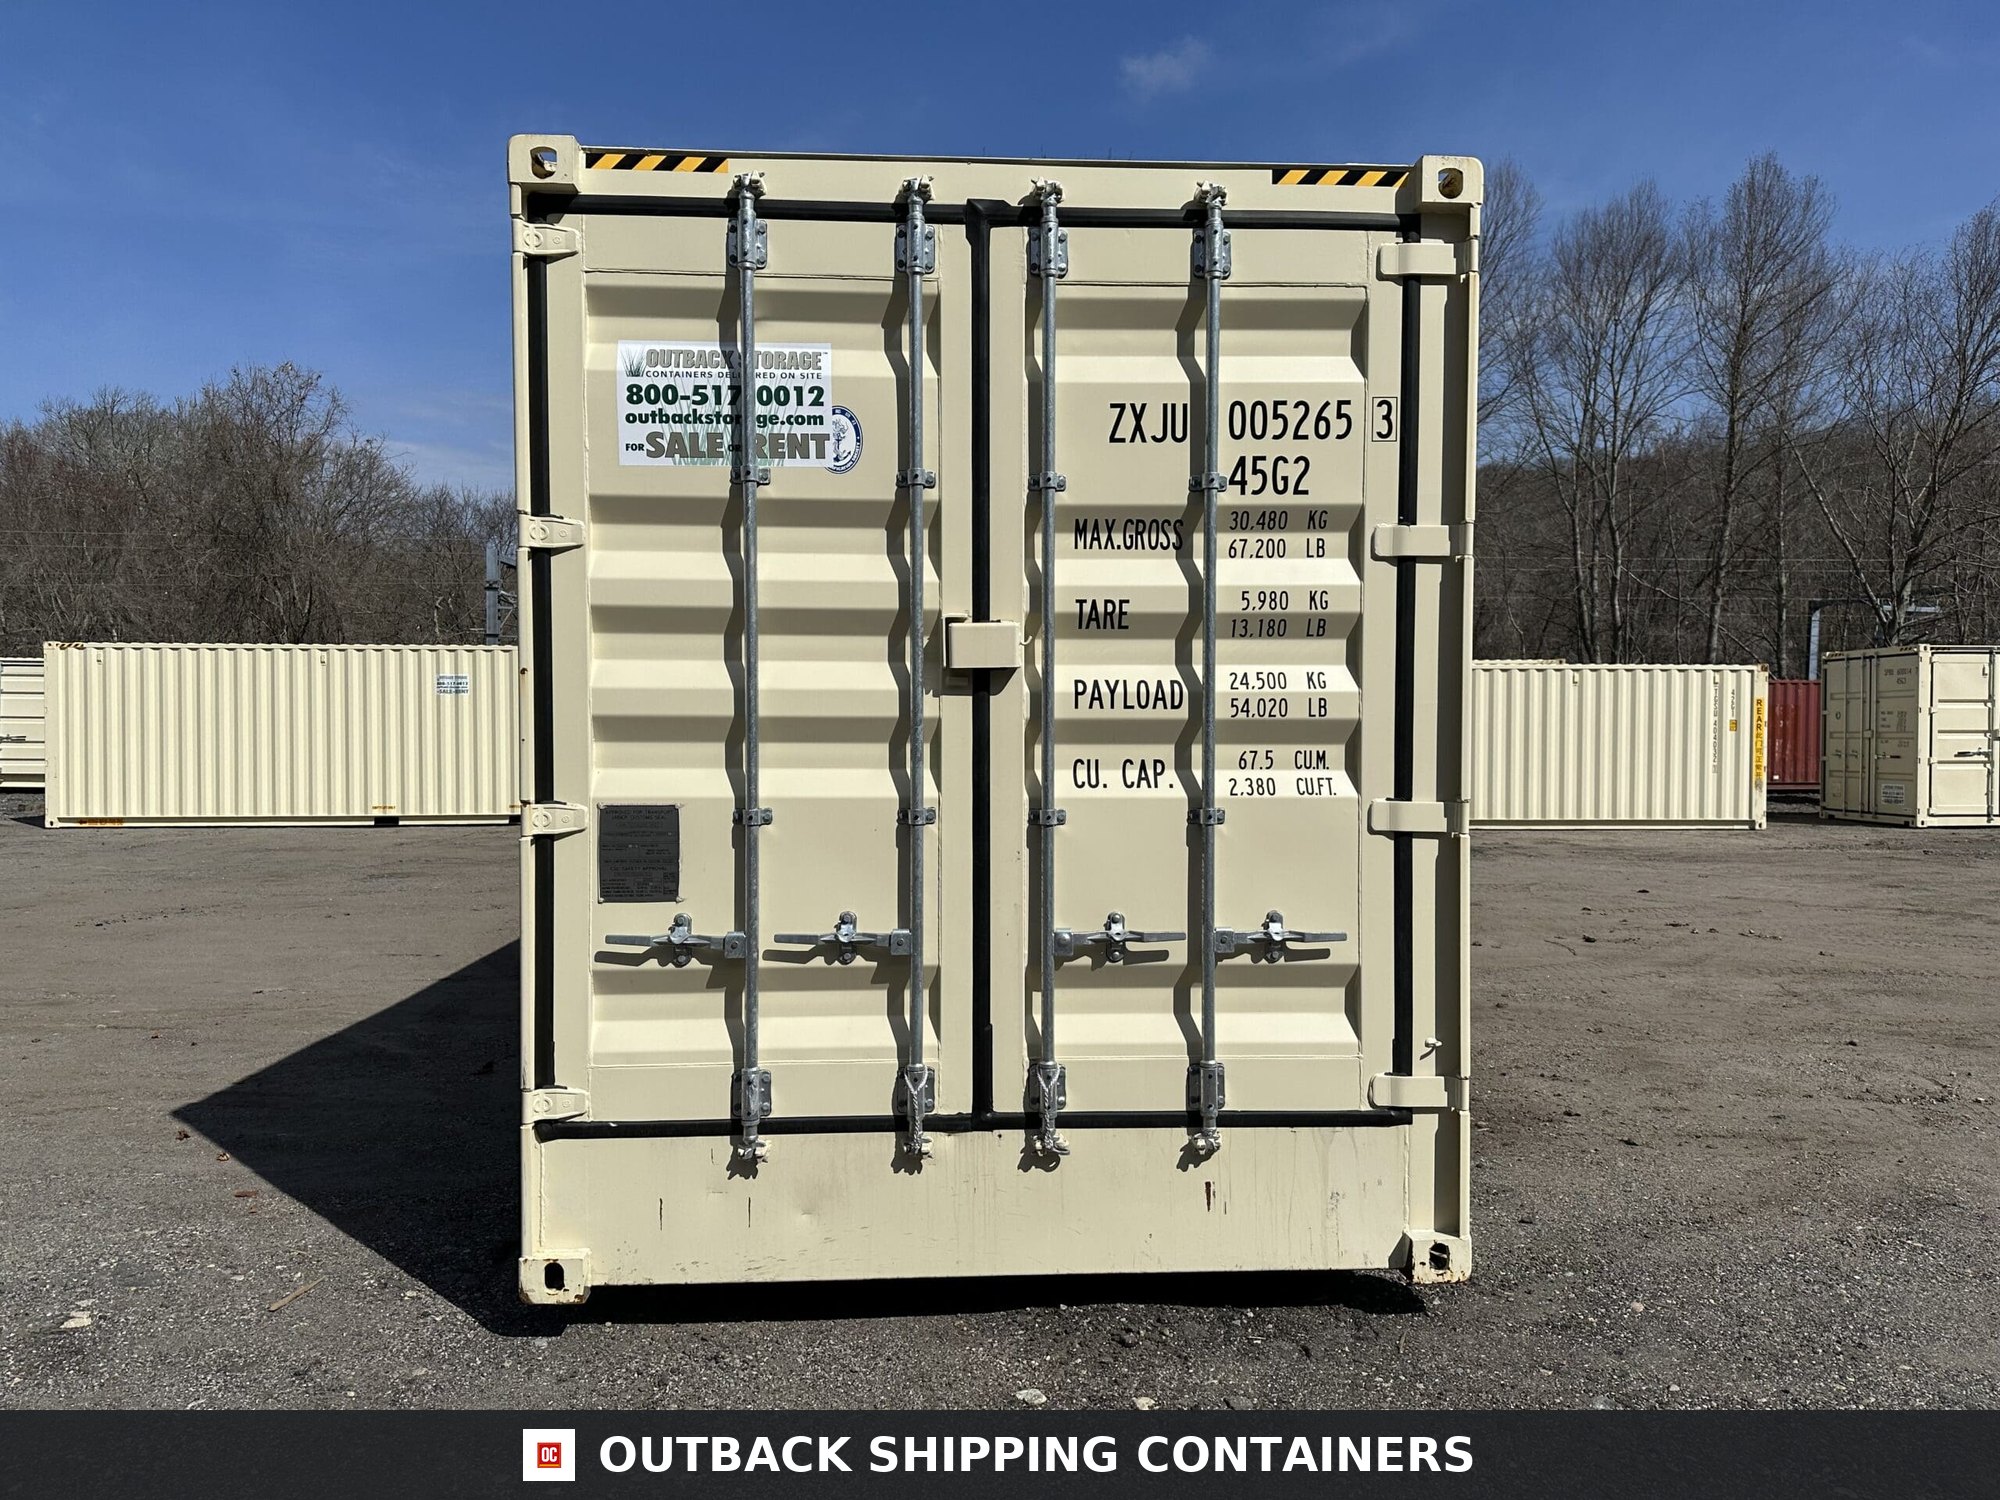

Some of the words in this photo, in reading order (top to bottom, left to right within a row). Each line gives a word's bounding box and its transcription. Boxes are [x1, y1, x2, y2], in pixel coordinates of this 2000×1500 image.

[645, 349, 734, 370] OUTBACK
[737, 350, 822, 371] TORAGE
[645, 370, 713, 379] CONTAINERS
[717, 371, 776, 380] DELIRED
[780, 371, 796, 380] ON
[799, 372, 823, 380] SITE
[625, 383, 825, 407] 800-5170012
[625, 408, 825, 429] outbackstorge.com
[1108, 403, 1188, 443] ZXJU
[1228, 400, 1352, 440] 005265
[1375, 399, 1393, 439] 3
[625, 443, 645, 452] FOR
[645, 431, 724, 460] SALE
[751, 432, 831, 460] RENT
[1228, 455, 1311, 496] 45G2
[1229, 510, 1288, 531] 30,480
[1307, 510, 1328, 530] KG
[1074, 518, 1184, 551] MAX.GROSS
[1228, 538, 1286, 559] 67,200
[1306, 538, 1326, 558] LB
[1241, 590, 1289, 611] 5,980
[1309, 590, 1329, 610] KG
[1075, 599, 1130, 630] TARE
[1231, 618, 1287, 638] 13,180
[1306, 618, 1326, 637] LB
[1229, 671, 1287, 690] 24,500
[1306, 672, 1327, 690] KG
[1074, 679, 1184, 710] PAYLOAD
[1230, 697, 1288, 718] 54,020
[1308, 698, 1327, 717] LB
[1238, 750, 1274, 770] 67.5
[1294, 750, 1330, 770] CU.M.
[1072, 759, 1108, 788] CU.
[1121, 759, 1174, 788] CAP.
[1228, 777, 1276, 796] 2,380
[1296, 777, 1337, 796] CU.FT.
